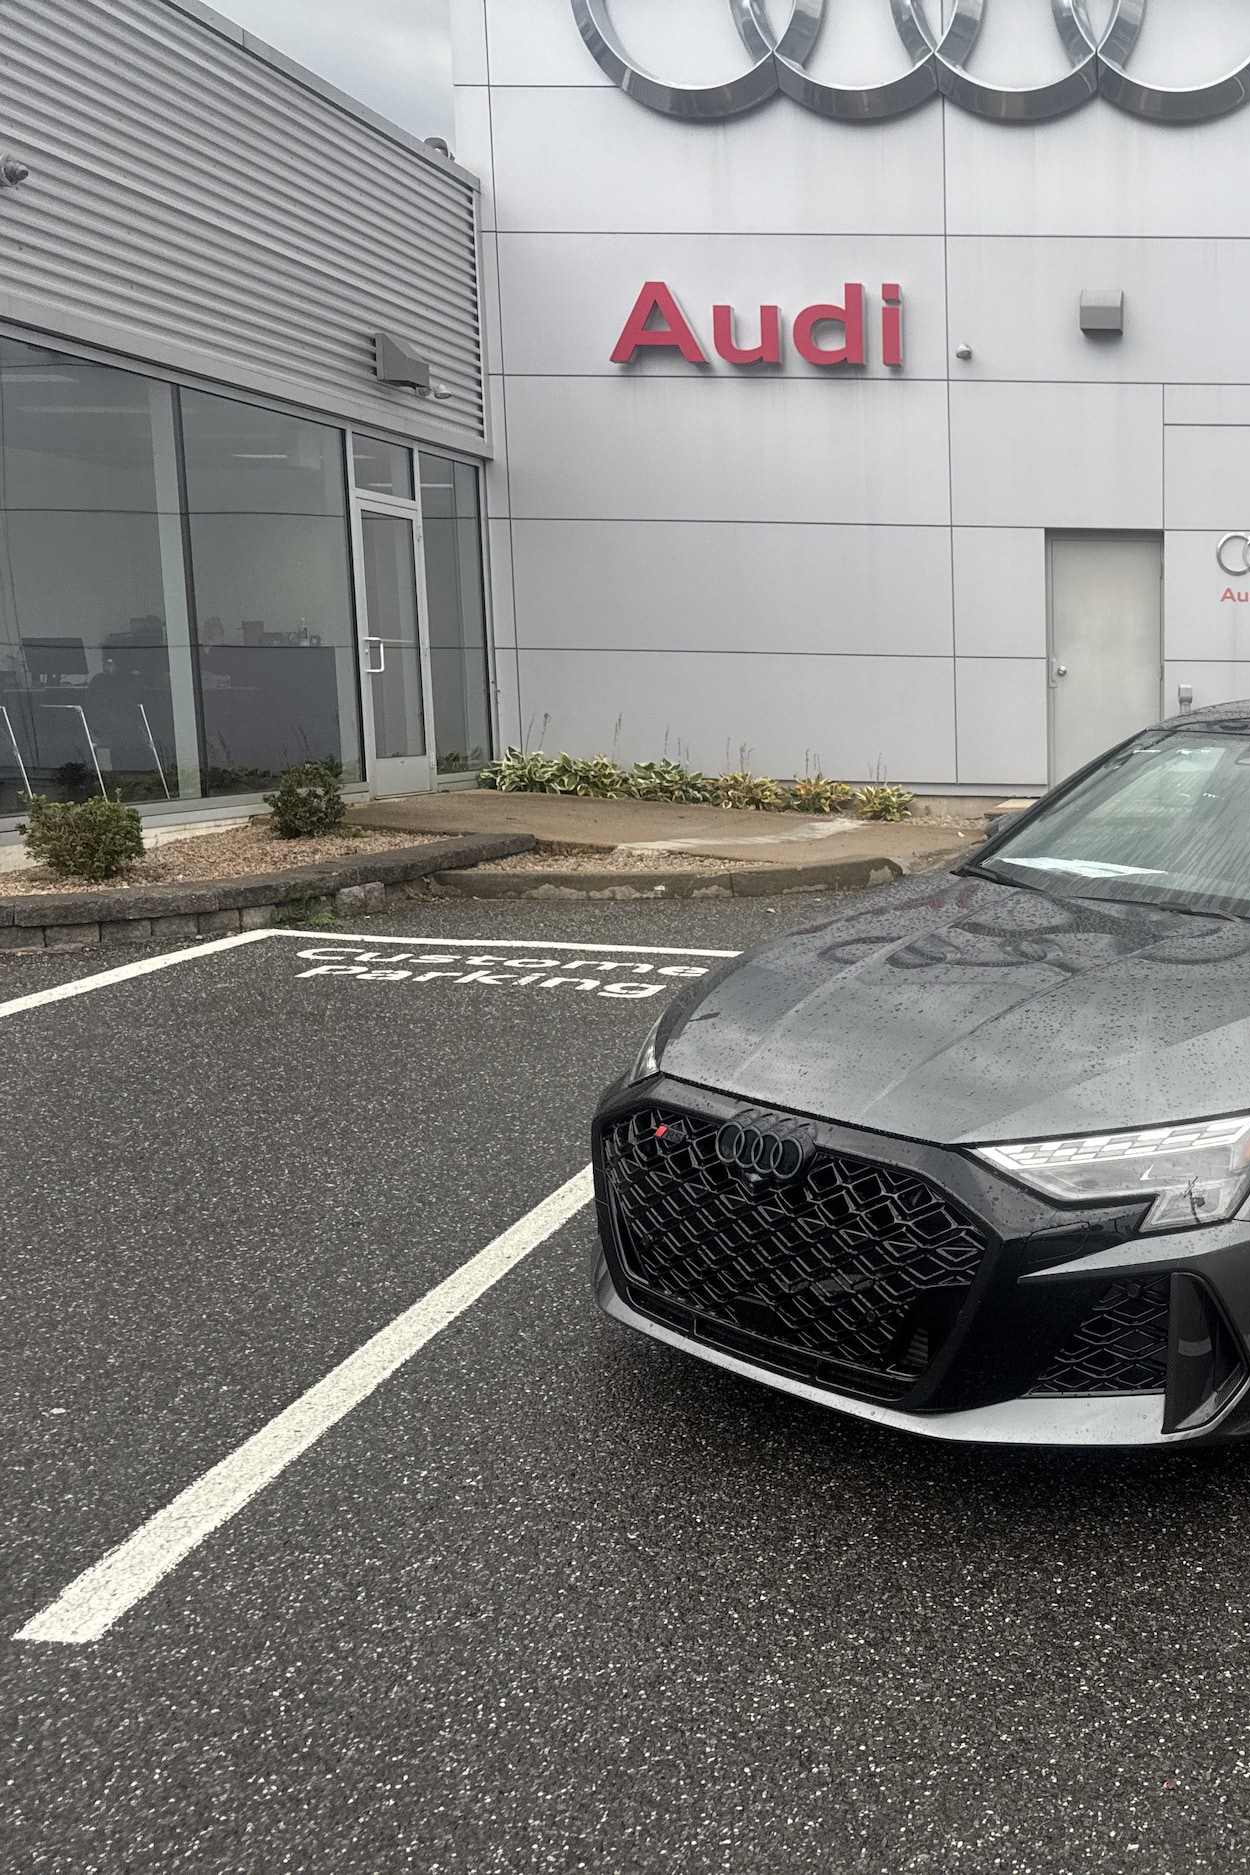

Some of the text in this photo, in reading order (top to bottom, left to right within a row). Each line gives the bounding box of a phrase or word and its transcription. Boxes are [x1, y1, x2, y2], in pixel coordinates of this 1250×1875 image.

[609, 281, 902, 366] Audi
[296, 947, 711, 977] Custome
[294, 964, 668, 999] Parking
